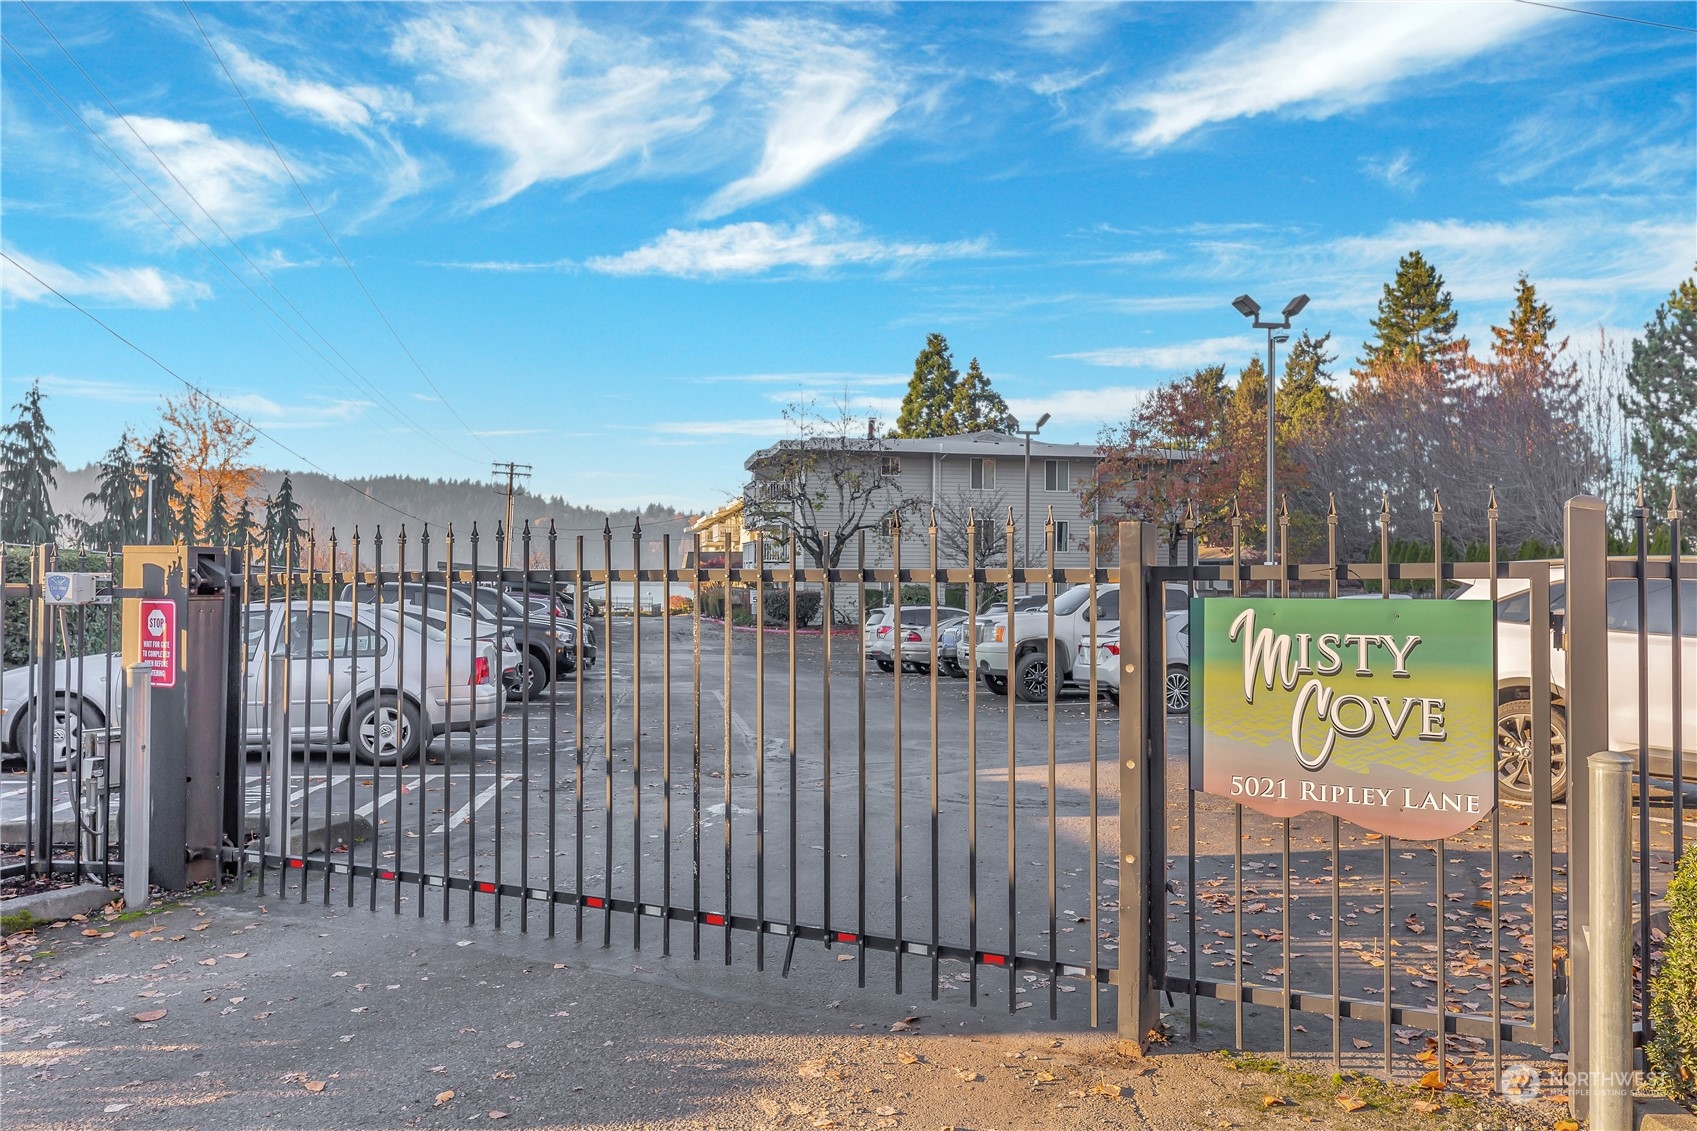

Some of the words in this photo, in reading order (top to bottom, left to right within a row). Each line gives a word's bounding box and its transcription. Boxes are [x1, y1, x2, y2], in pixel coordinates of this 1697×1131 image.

[149, 618, 164, 628] STOP
[1229, 608, 1422, 703] MISTY
[1291, 679, 1447, 772] COVE
[1230, 775, 1289, 800] 5021
[1300, 779, 1394, 807] RIPLEY
[1402, 787, 1480, 814] LANE
